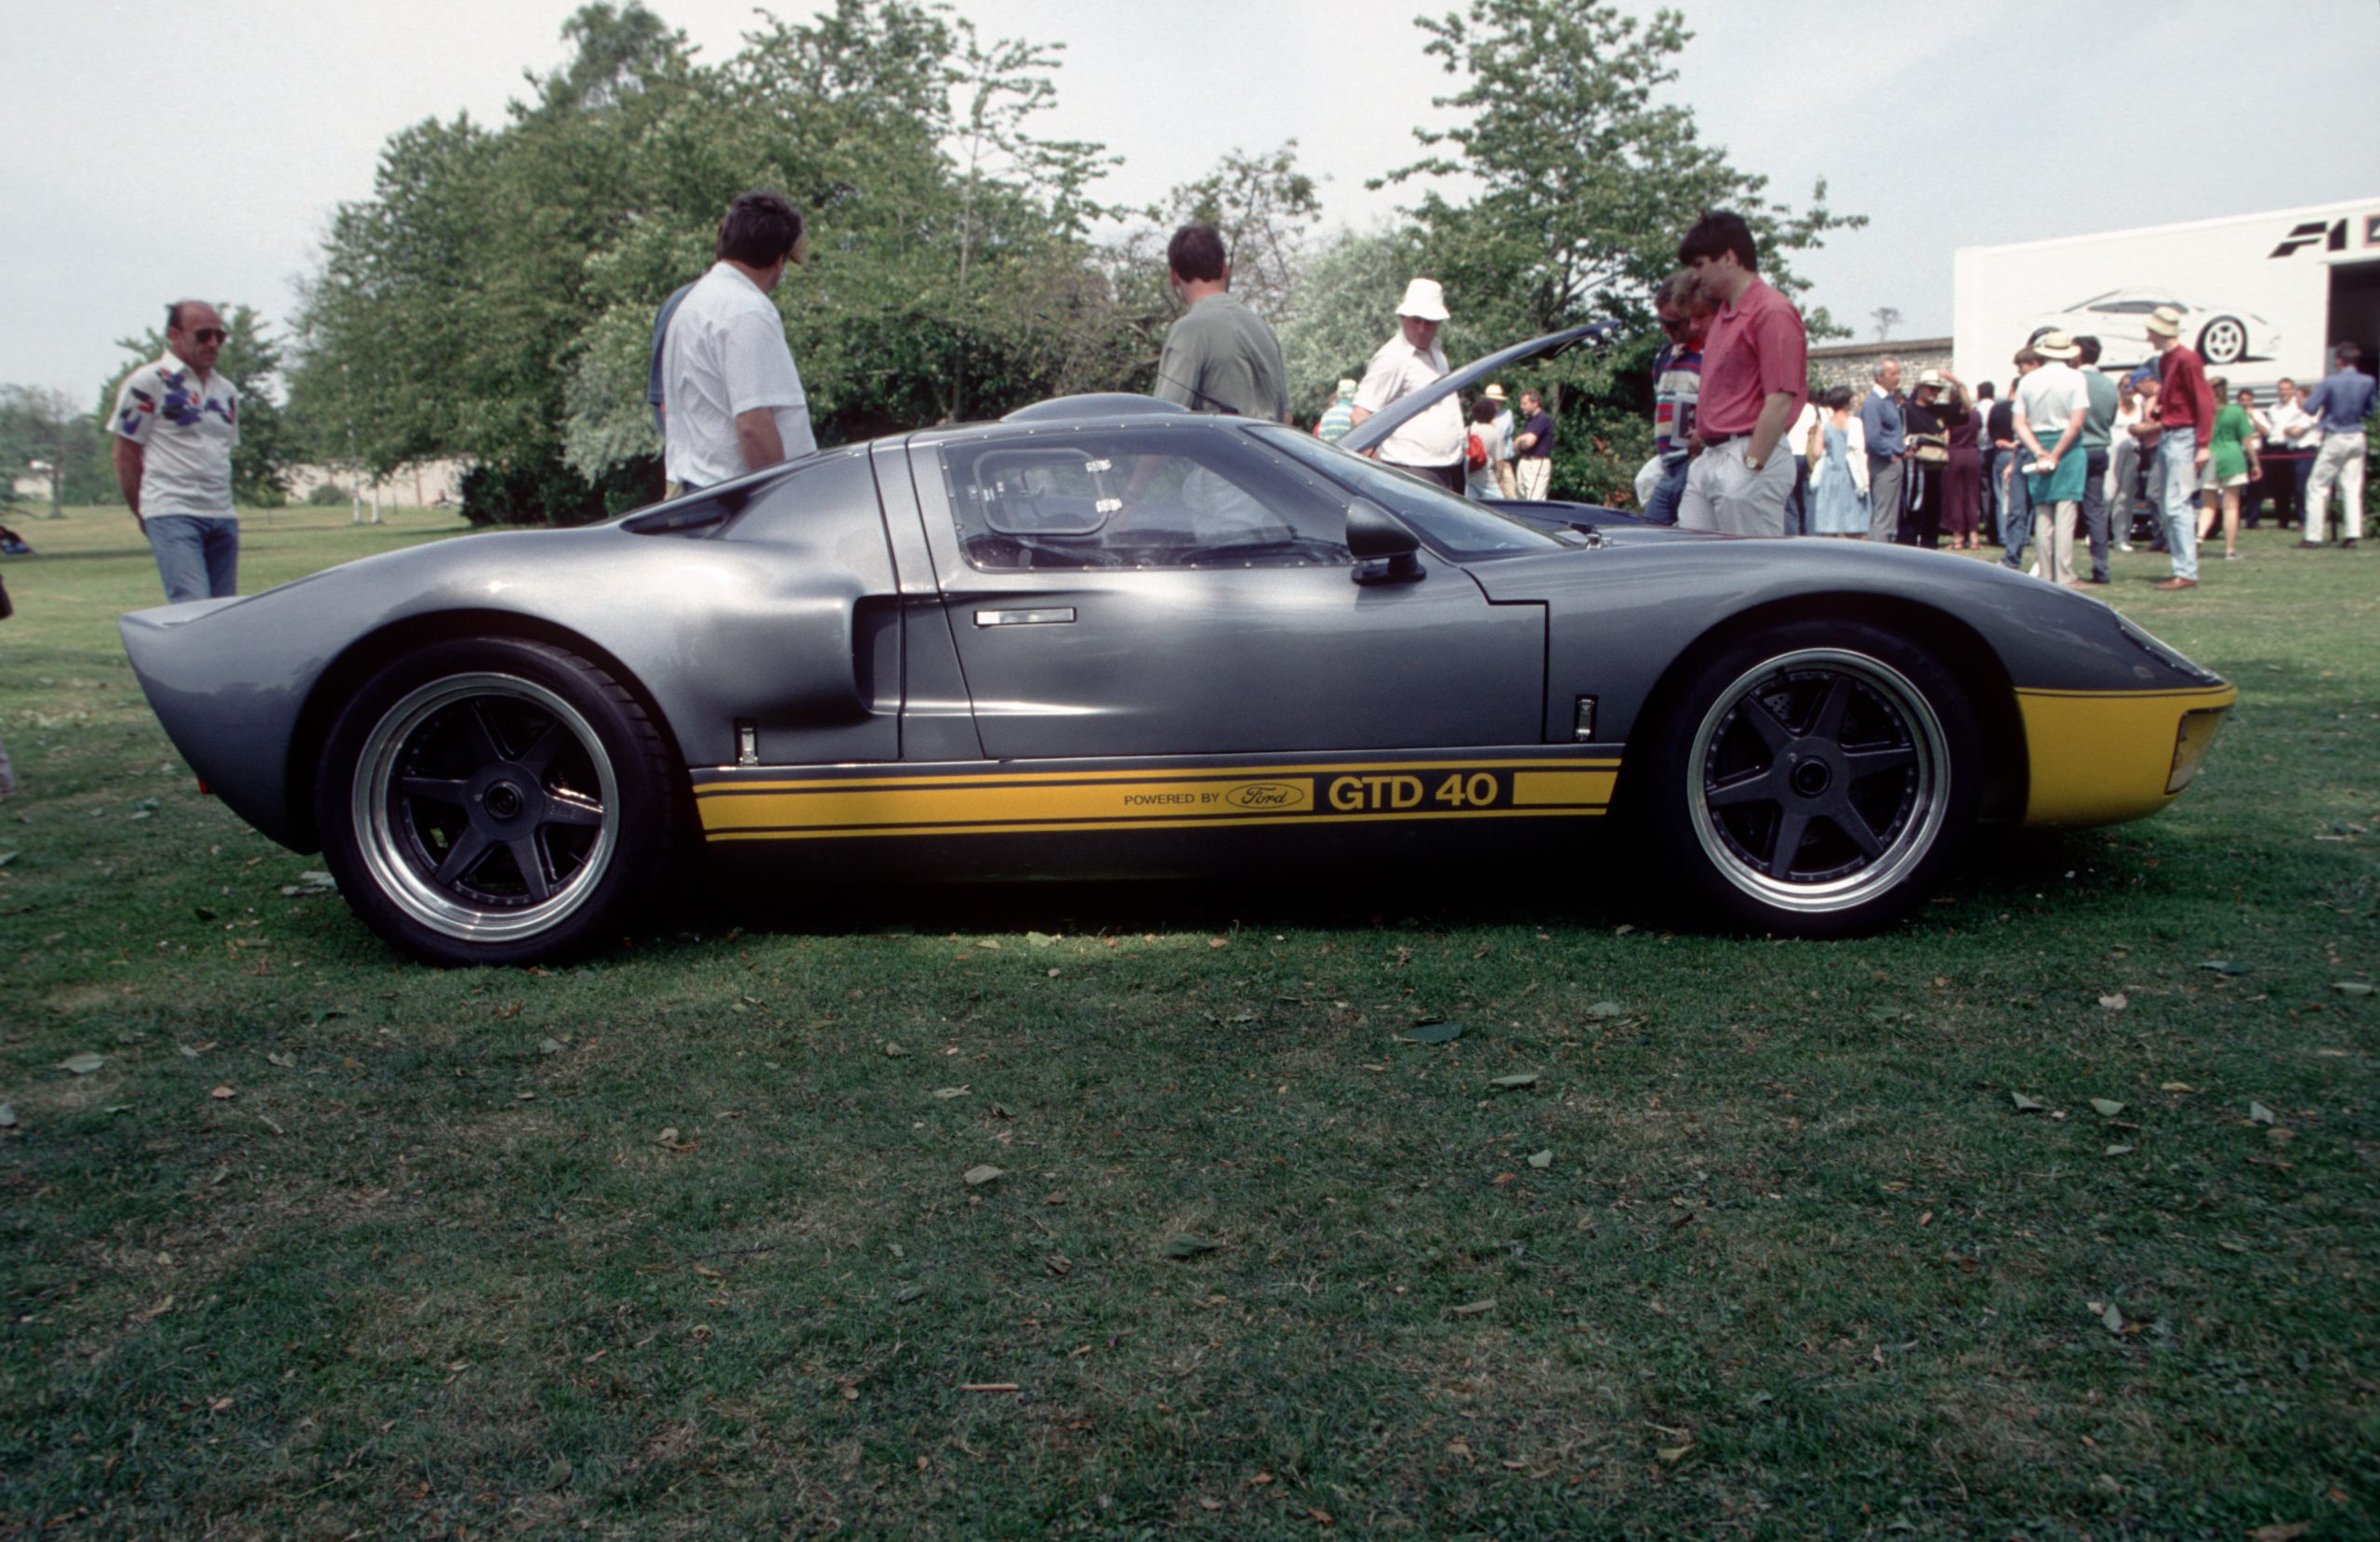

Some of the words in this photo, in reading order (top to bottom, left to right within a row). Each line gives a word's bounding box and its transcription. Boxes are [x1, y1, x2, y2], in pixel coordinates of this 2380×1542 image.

[2268, 217, 2348, 258] F1
[1124, 793, 1195, 806] POWERED
[1201, 792, 1220, 804] BY
[1240, 787, 1289, 805] Ford
[1329, 775, 1423, 811] GTD
[1435, 772, 1498, 807] 40
